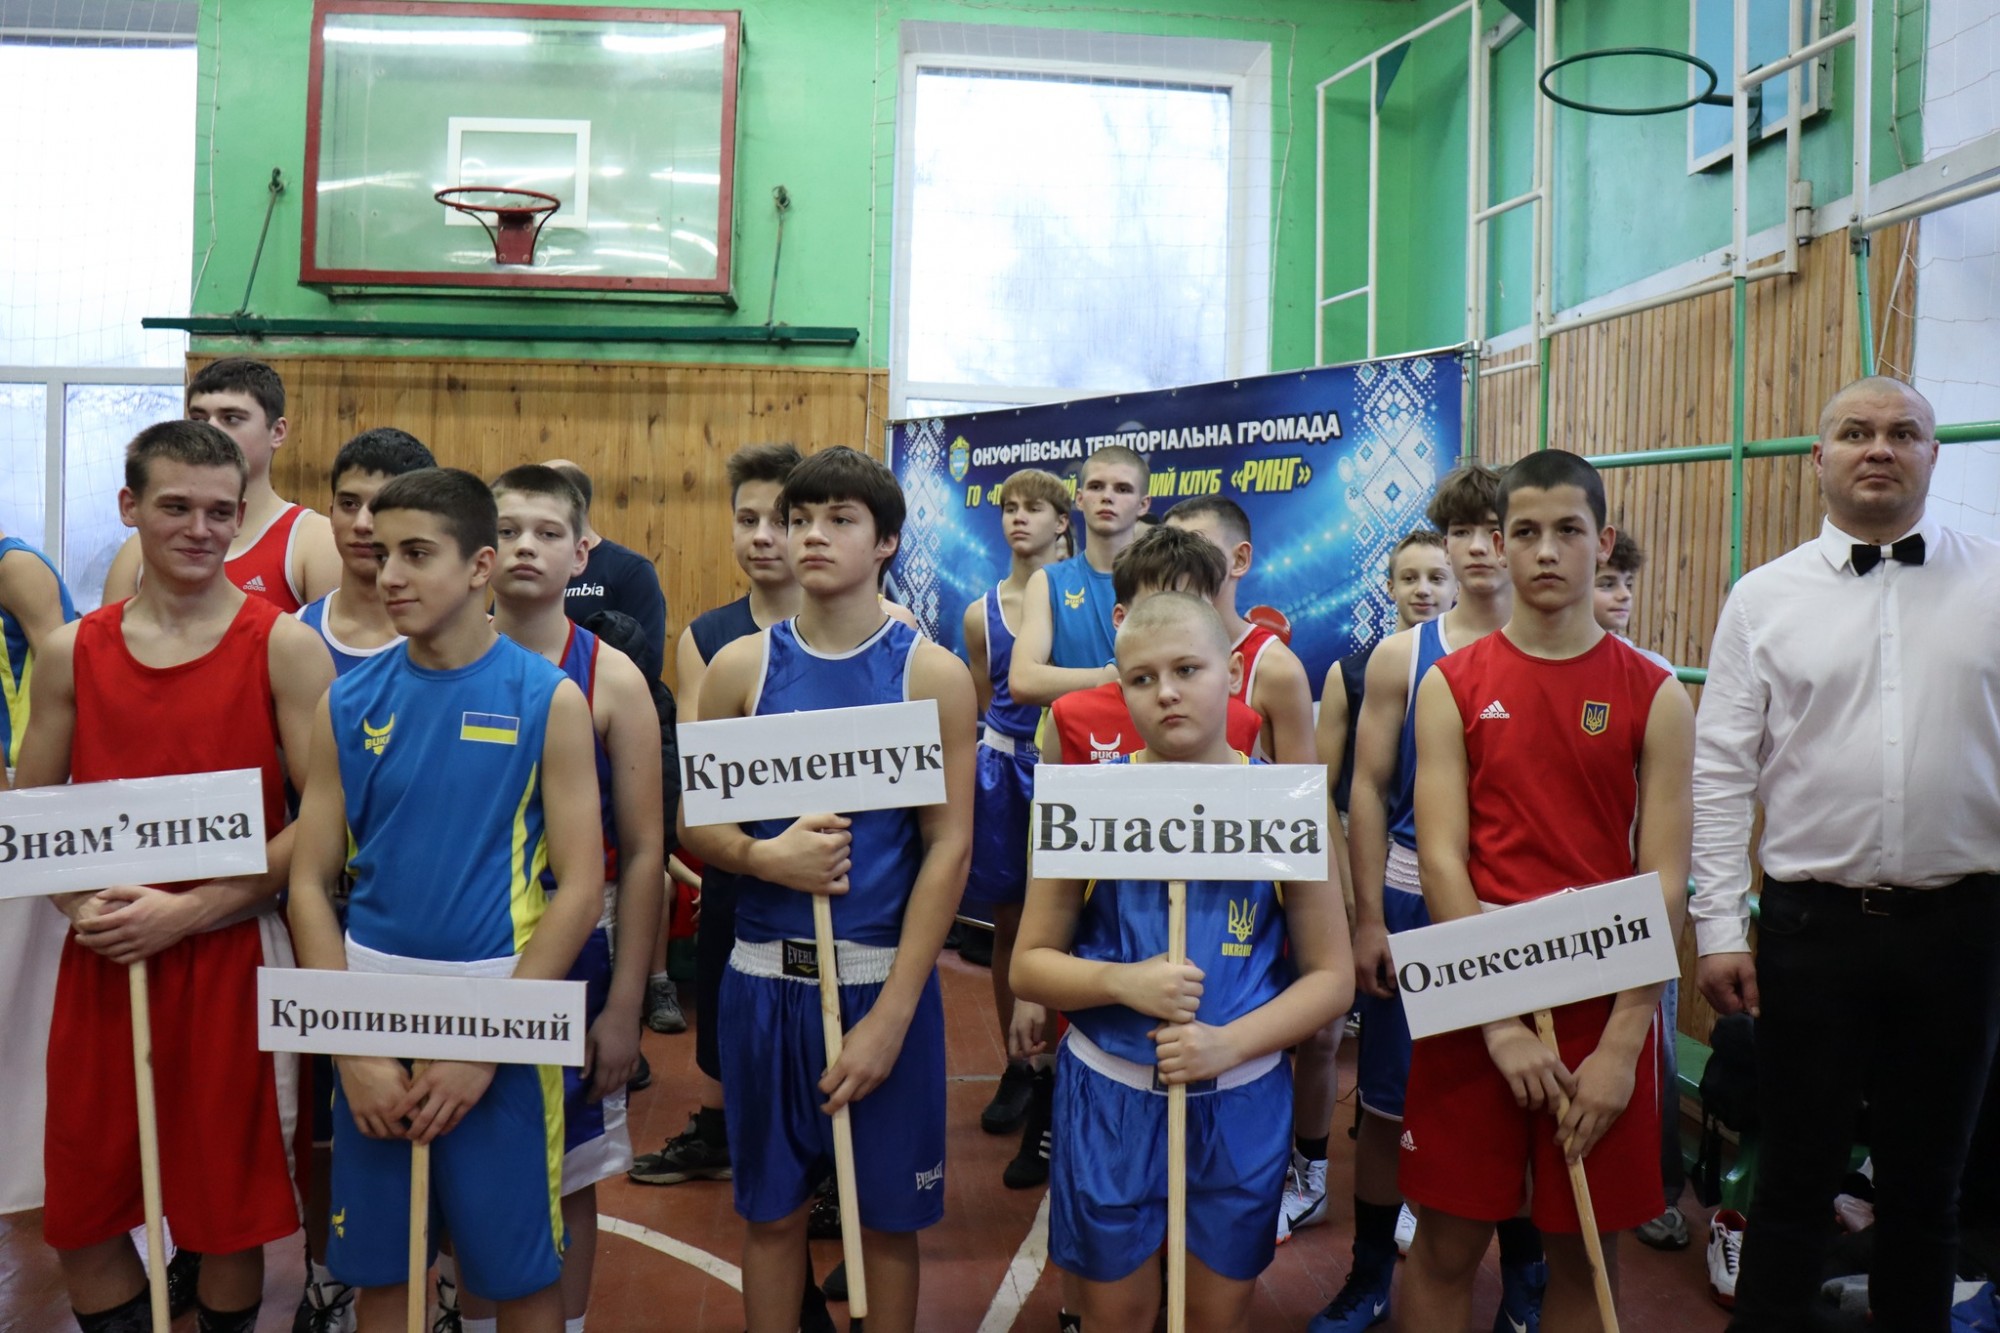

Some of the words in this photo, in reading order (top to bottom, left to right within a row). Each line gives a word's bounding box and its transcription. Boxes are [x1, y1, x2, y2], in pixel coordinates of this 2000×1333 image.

[972, 438, 1082, 467] ОНУФРІЇВСЬКА
[1085, 423, 1233, 457] ТЕРИТОРІАЛЬНА
[1237, 413, 1341, 445] ГРОМАДА
[966, 484, 982, 508] ГО
[1178, 468, 1223, 496] КЛУБ
[1230, 457, 1313, 493] «РИНГ»
[1479, 711, 1510, 720] adidas
[681, 743, 942, 800] Кременчук
[0, 812, 252, 863] Знам’янка
[1034, 802, 1322, 855] Власівка
[1398, 914, 1651, 993] Олександрія
[269, 999, 571, 1042] Кропивницький
